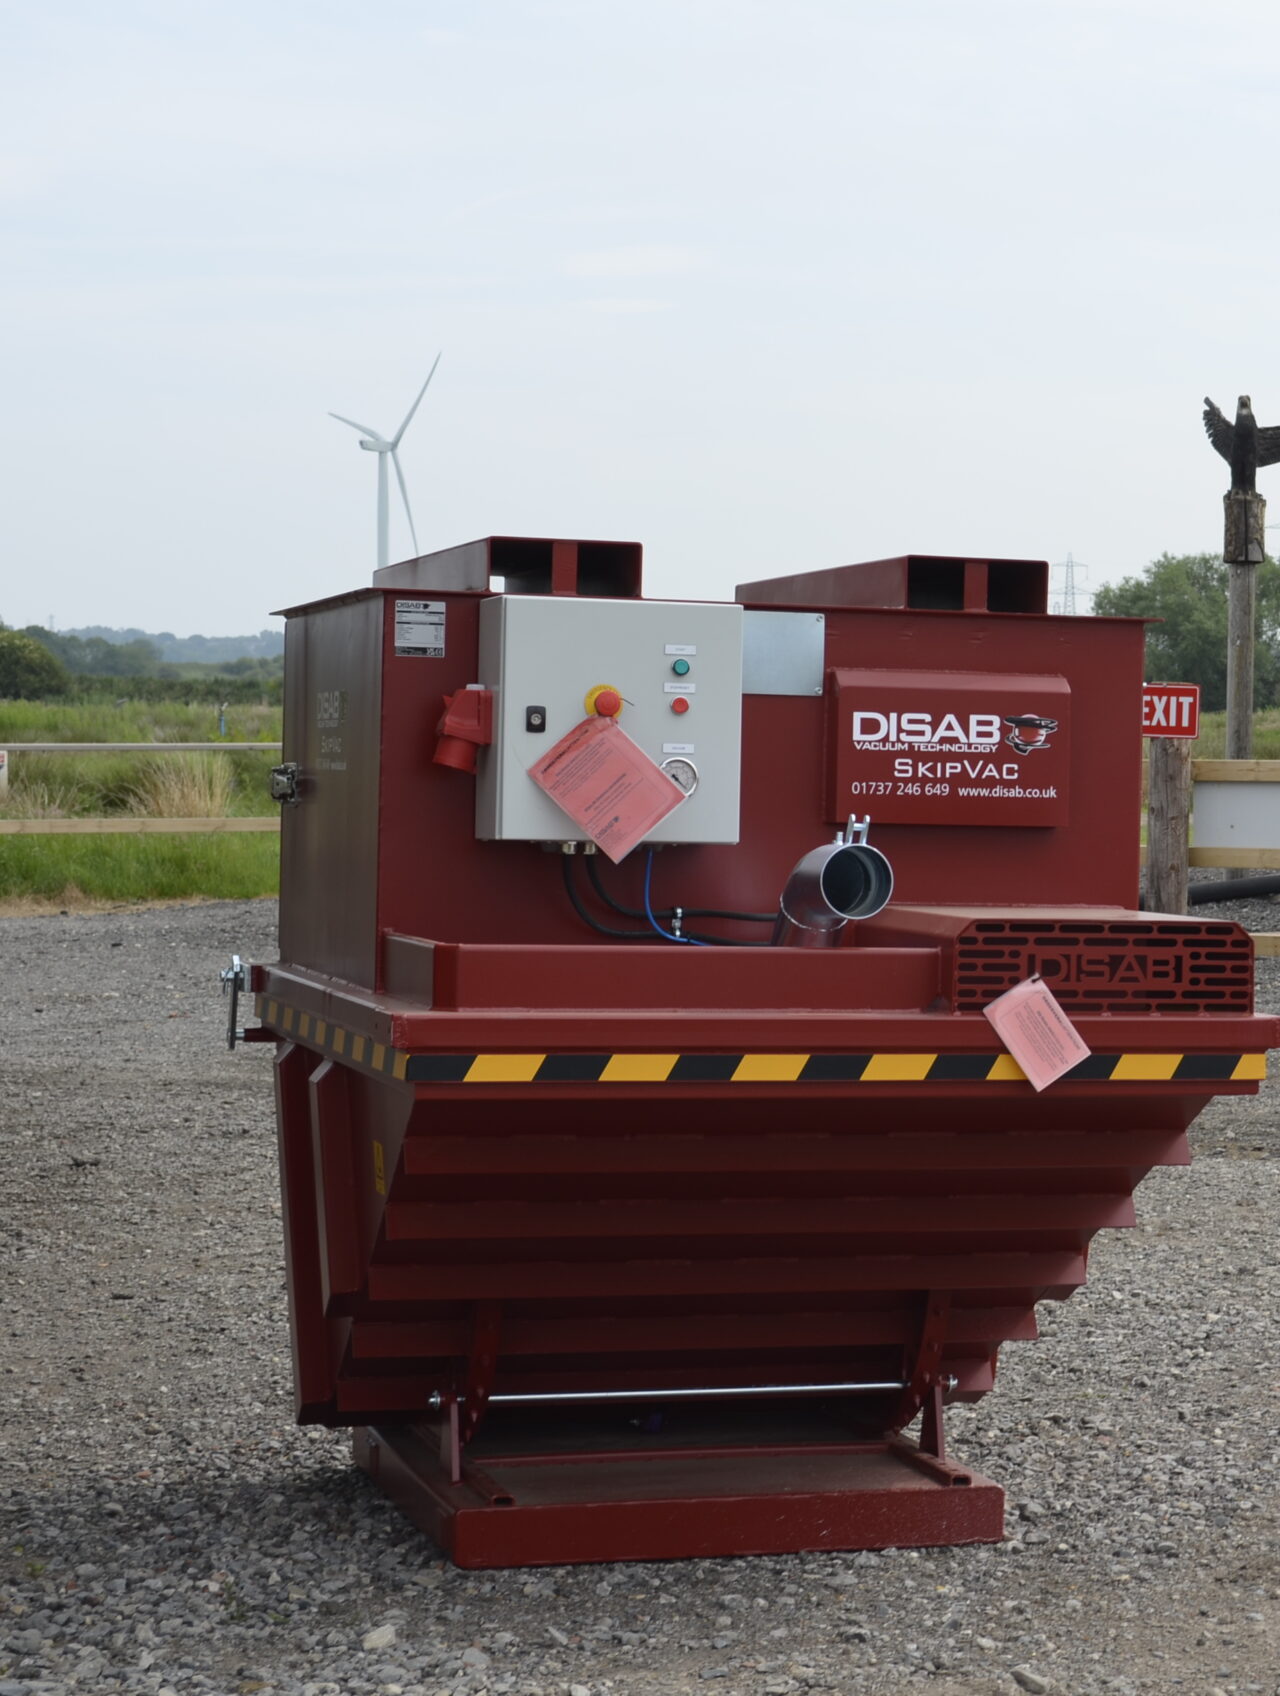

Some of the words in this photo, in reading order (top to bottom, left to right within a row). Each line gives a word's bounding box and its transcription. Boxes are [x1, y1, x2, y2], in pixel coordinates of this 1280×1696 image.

[1142, 696, 1194, 727] EXIT
[852, 711, 1001, 744] DISAB
[853, 741, 909, 752] VACUUM
[911, 742, 999, 753] TECHNOLOGY
[851, 782, 892, 795] 01737
[896, 783, 921, 796] 246
[924, 783, 950, 796] 649
[957, 785, 1057, 798] www.disab.co.uk
[1034, 952, 1177, 984] DISAB
